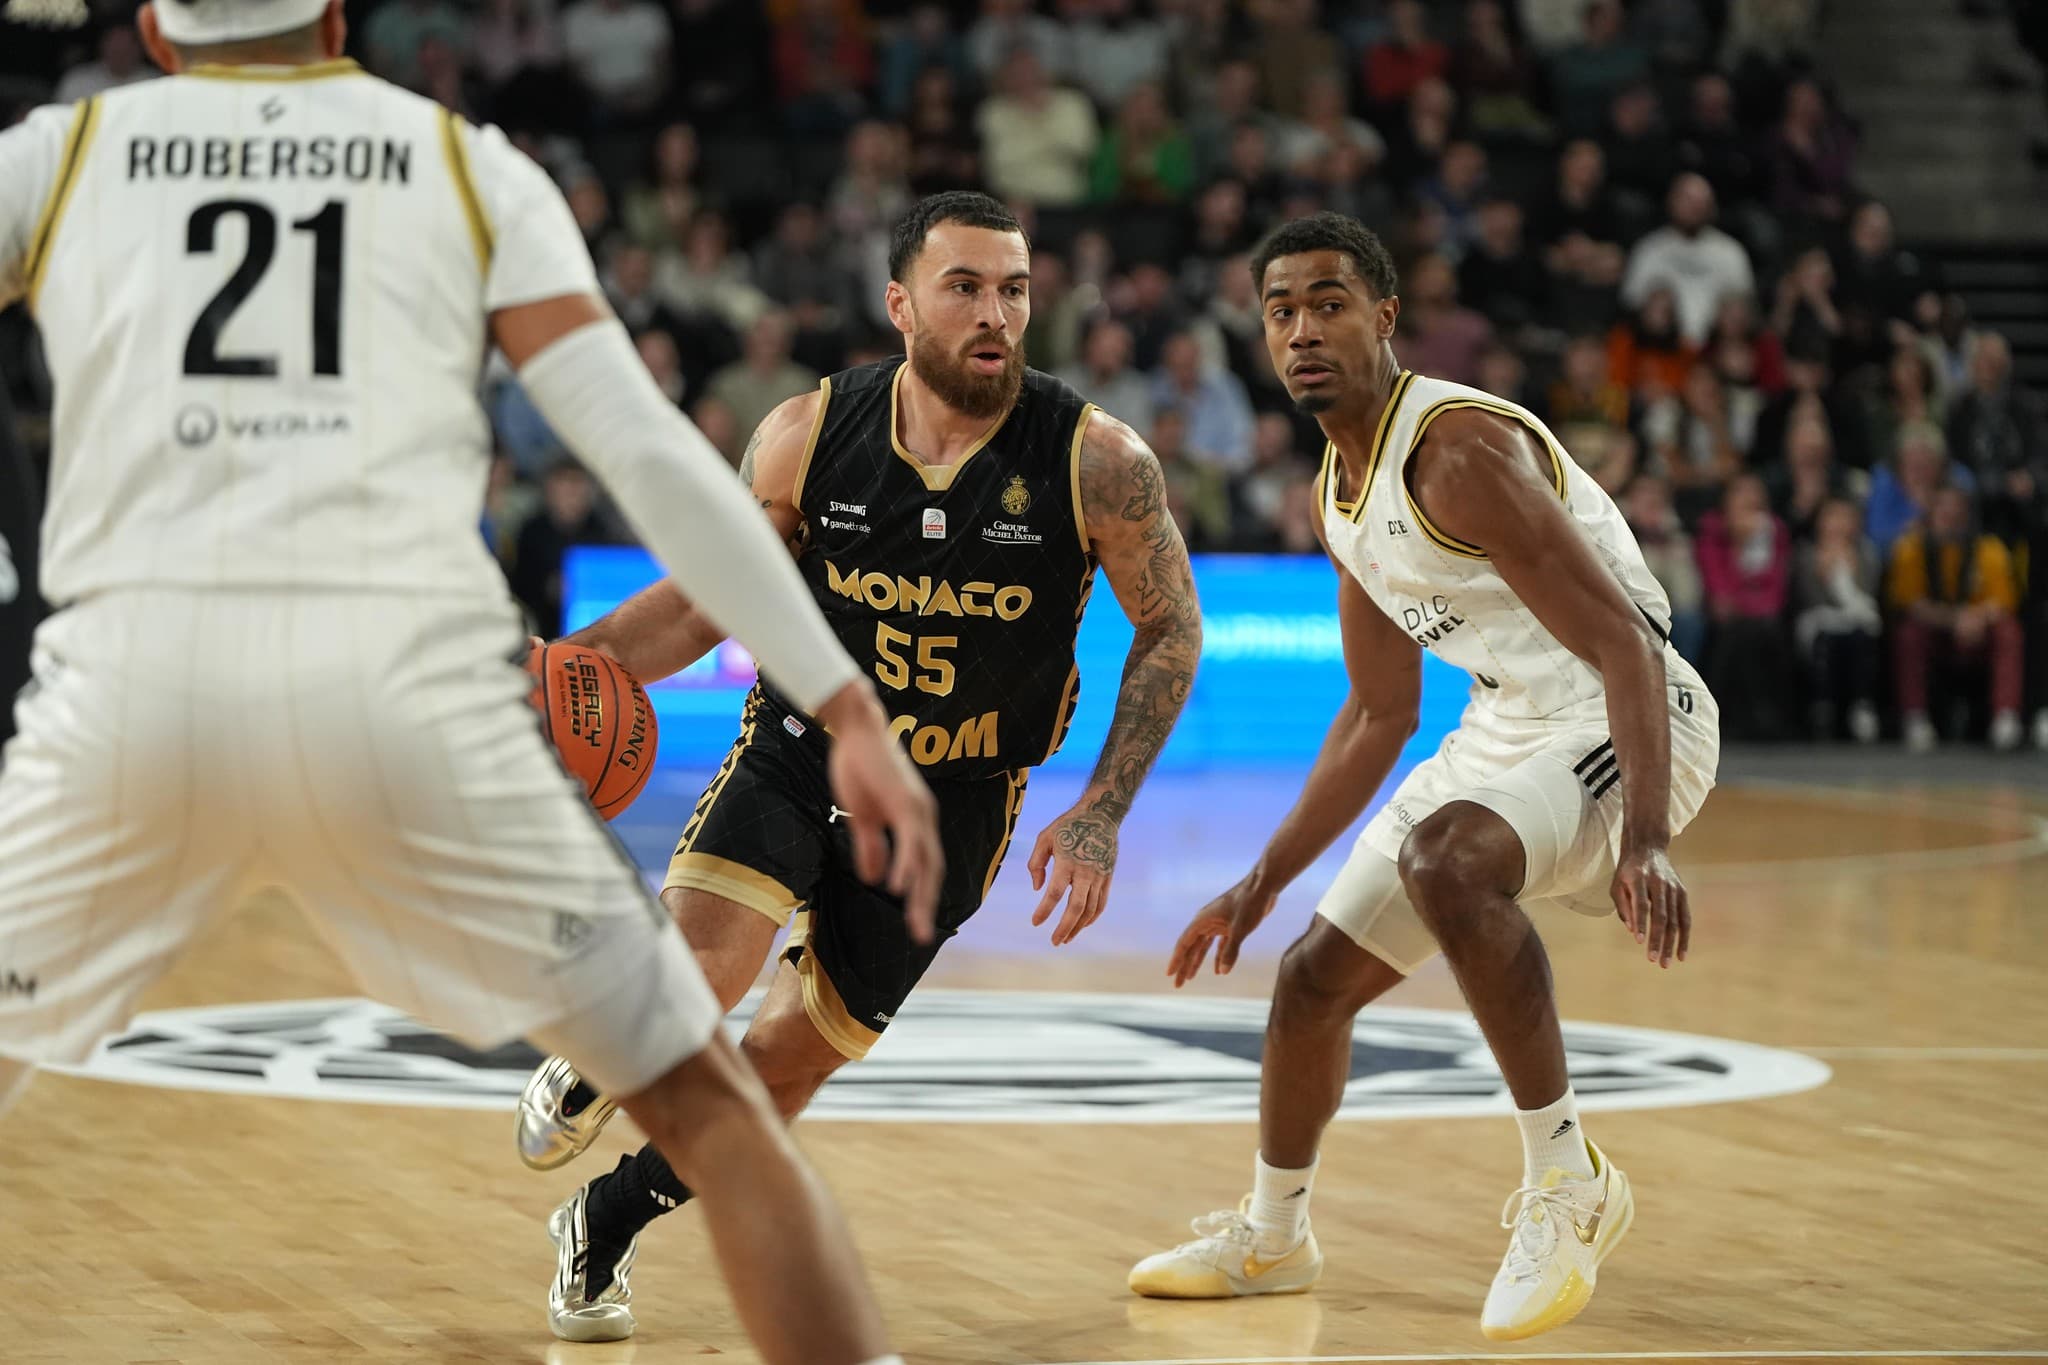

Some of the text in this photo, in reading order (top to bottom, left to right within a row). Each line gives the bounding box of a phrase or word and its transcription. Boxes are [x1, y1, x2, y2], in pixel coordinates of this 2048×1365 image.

[127, 136, 412, 184] ROBERSON
[182, 196, 348, 377] 21
[829, 500, 867, 517] SPALDING
[982, 528, 1043, 541] MICHEL PASTOR
[993, 520, 1030, 533] GROUPE
[824, 559, 1034, 622] MONACO
[875, 620, 959, 697] 55
[576, 653, 603, 748] LEGACY
[612, 658, 646, 771] ALDING
